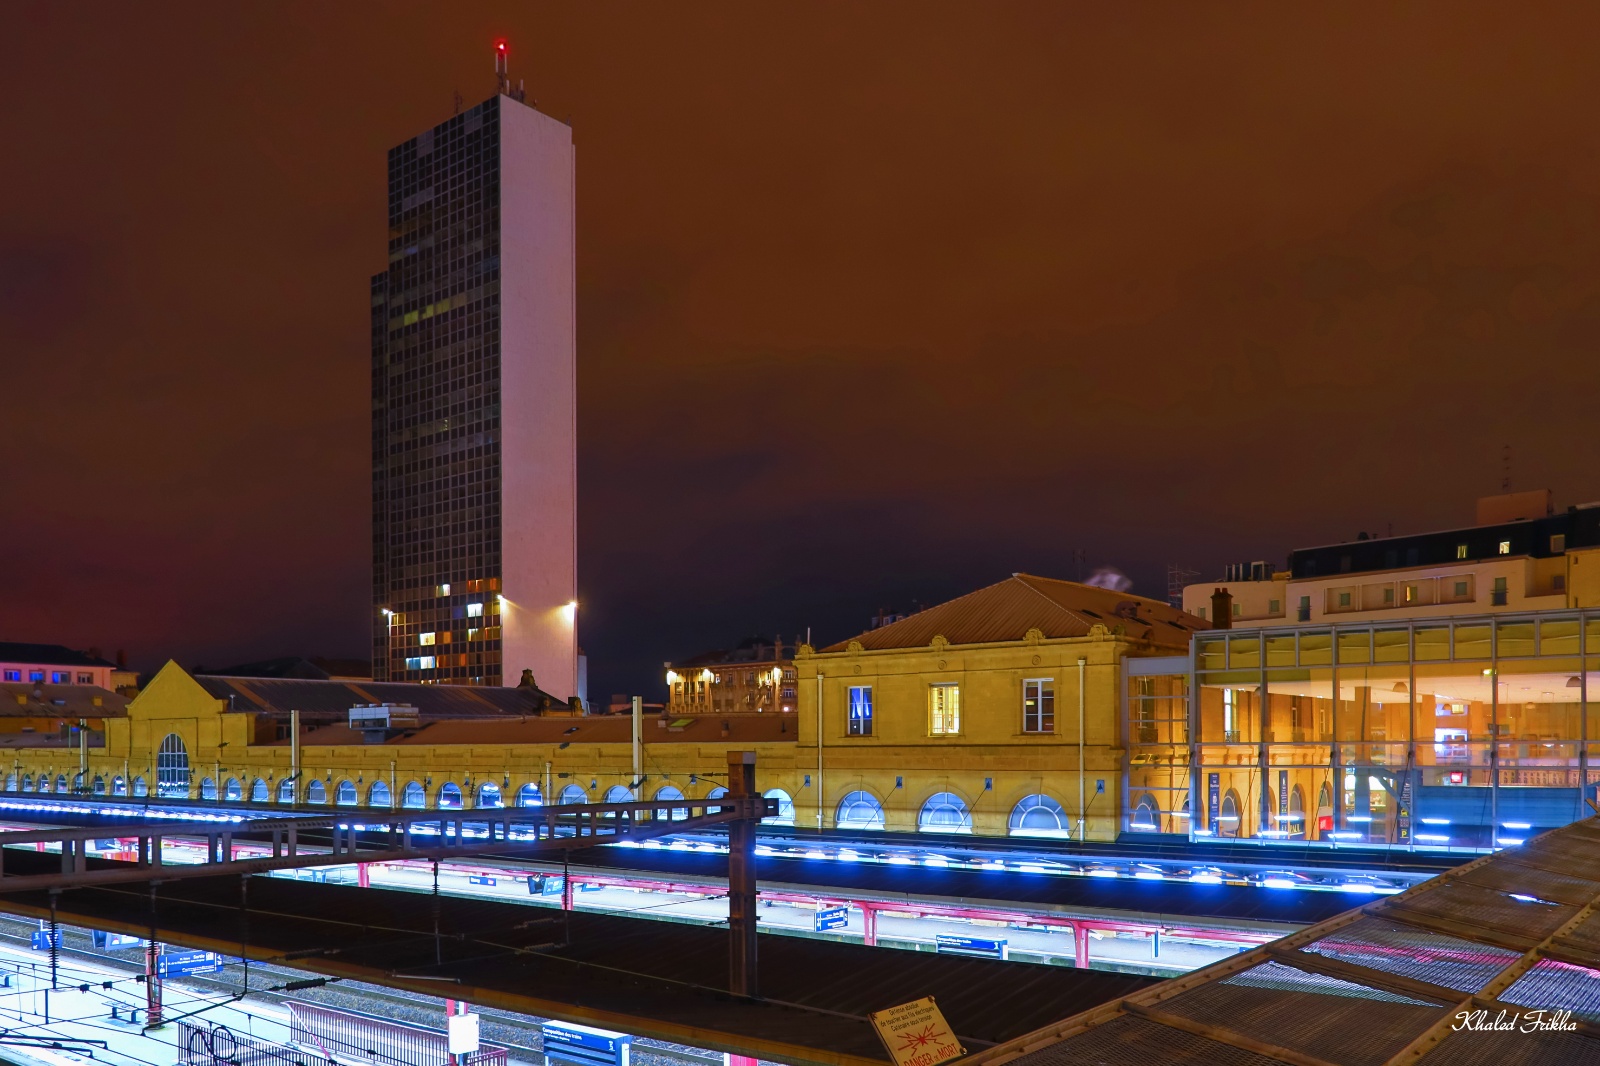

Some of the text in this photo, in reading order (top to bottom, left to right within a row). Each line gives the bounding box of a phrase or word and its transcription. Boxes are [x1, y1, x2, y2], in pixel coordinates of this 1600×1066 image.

[886, 1016, 901, 1025] toucher
[542, 1027, 564, 1036] Composition
[937, 1043, 958, 1059] MORT
